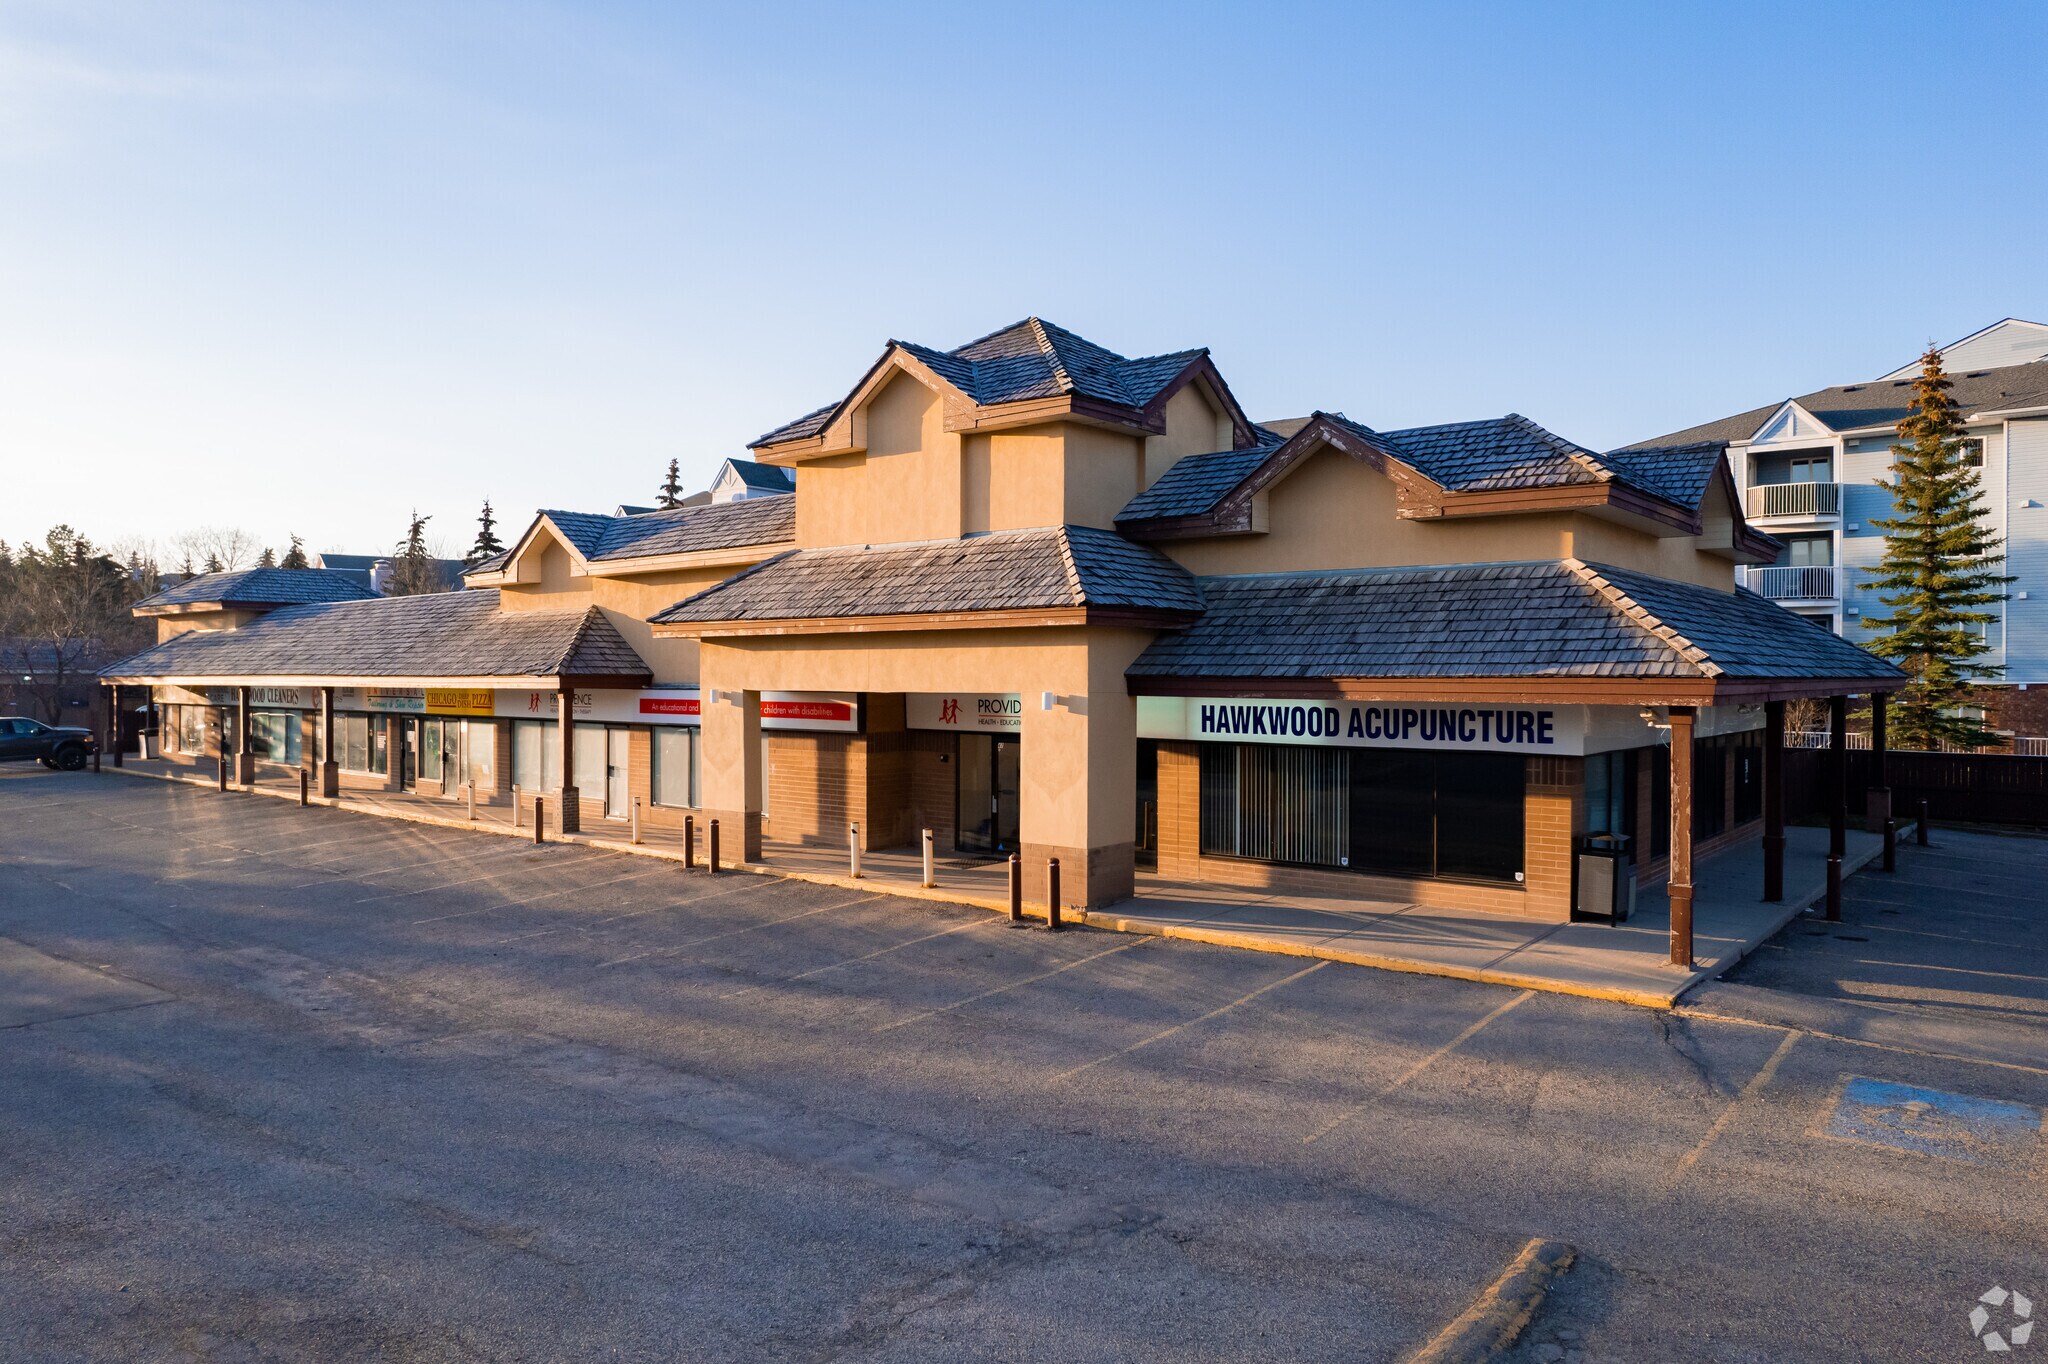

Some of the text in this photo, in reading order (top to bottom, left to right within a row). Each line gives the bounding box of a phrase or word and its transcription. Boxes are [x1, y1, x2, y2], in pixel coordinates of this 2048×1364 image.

[267, 688, 299, 704] CLEANERS
[427, 692, 492, 705] CHICAGO PIZZA
[457, 700, 471, 708] DISH
[660, 702, 688, 711] educational
[688, 703, 699, 711] and
[763, 704, 786, 714] children
[788, 705, 800, 714] with
[801, 705, 833, 716] disabilities
[1201, 705, 1554, 744] HAWKWOOD ACUPUNCTURE
